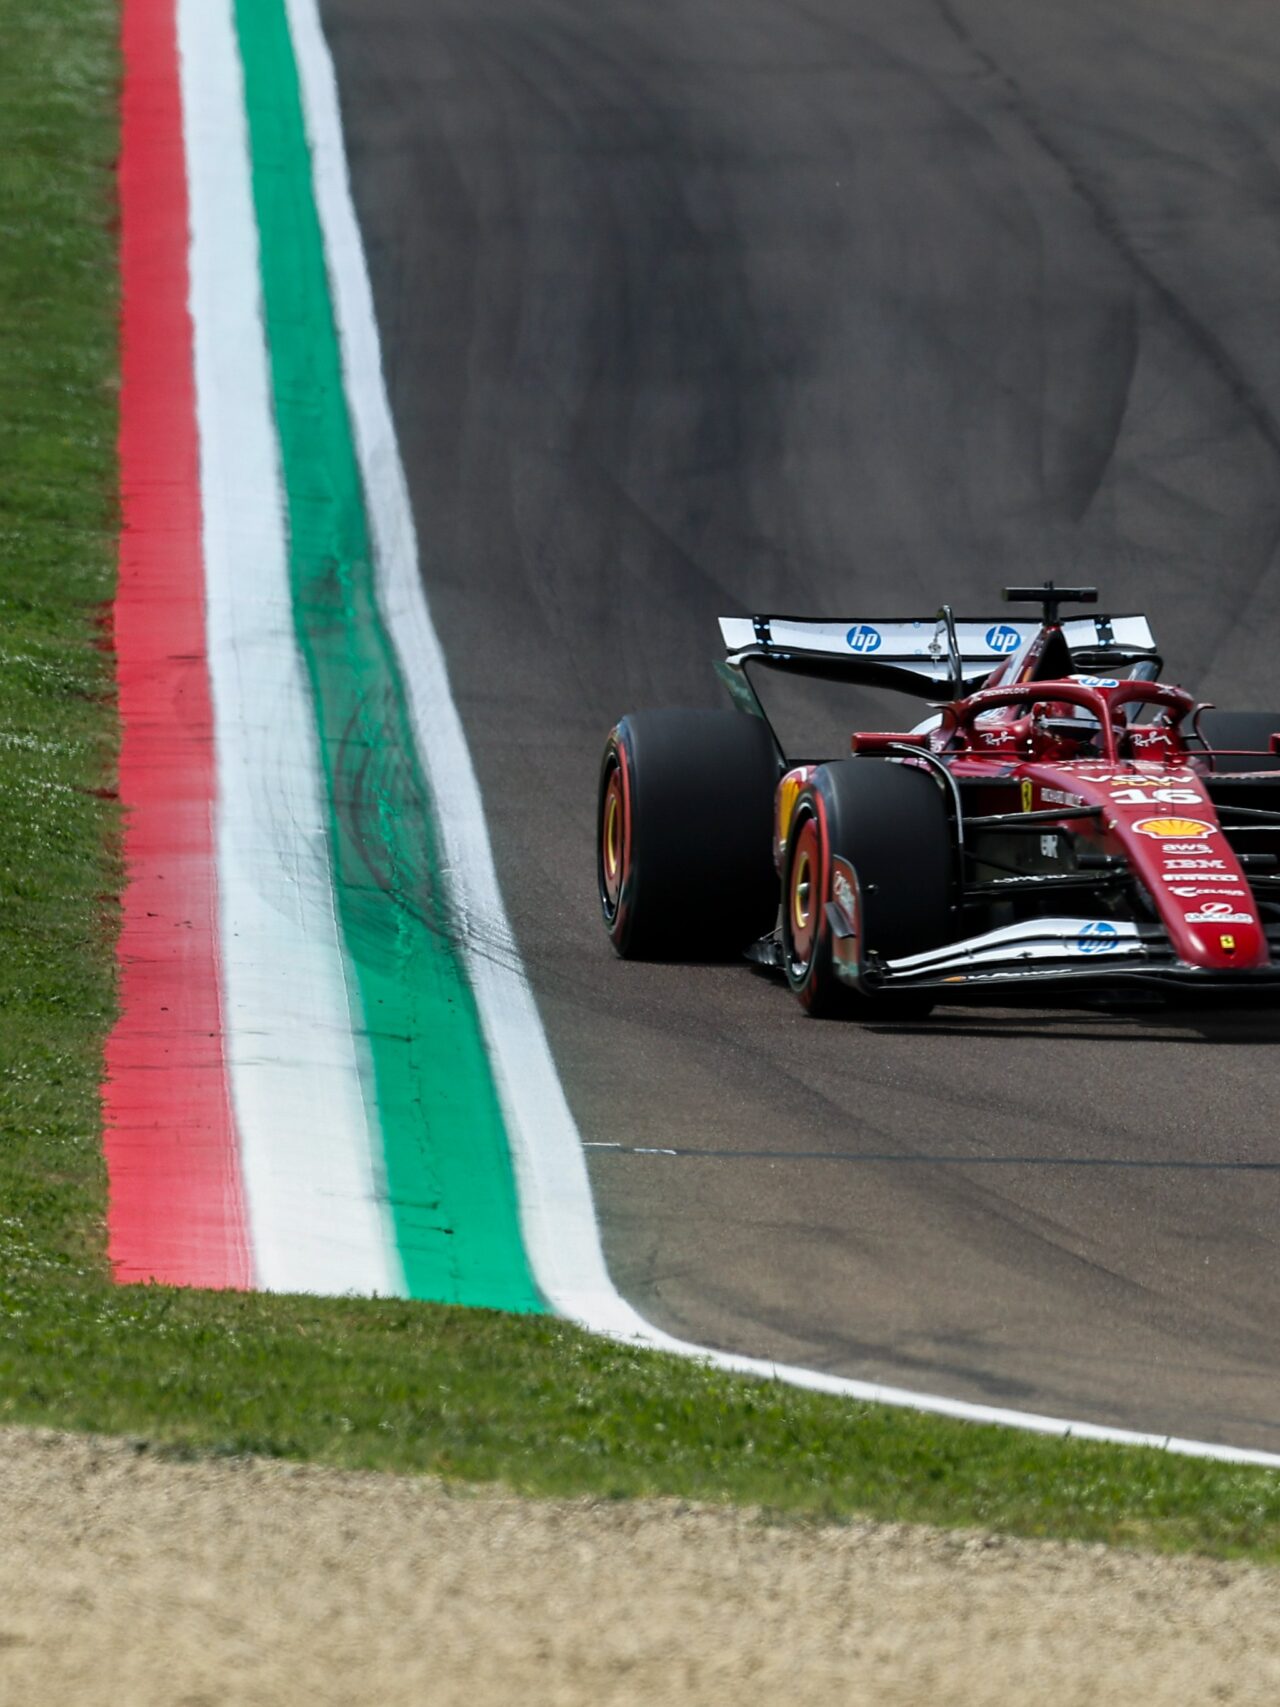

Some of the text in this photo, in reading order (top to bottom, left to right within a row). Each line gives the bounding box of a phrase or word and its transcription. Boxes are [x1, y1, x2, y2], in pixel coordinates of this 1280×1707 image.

[851, 626, 878, 652] hp
[989, 626, 1017, 652] hp
[1077, 774, 1193, 783] VGW
[1109, 788, 1203, 804] 16
[1162, 843, 1211, 852] aws
[1163, 859, 1226, 869] IBM
[1080, 922, 1117, 953] hp
